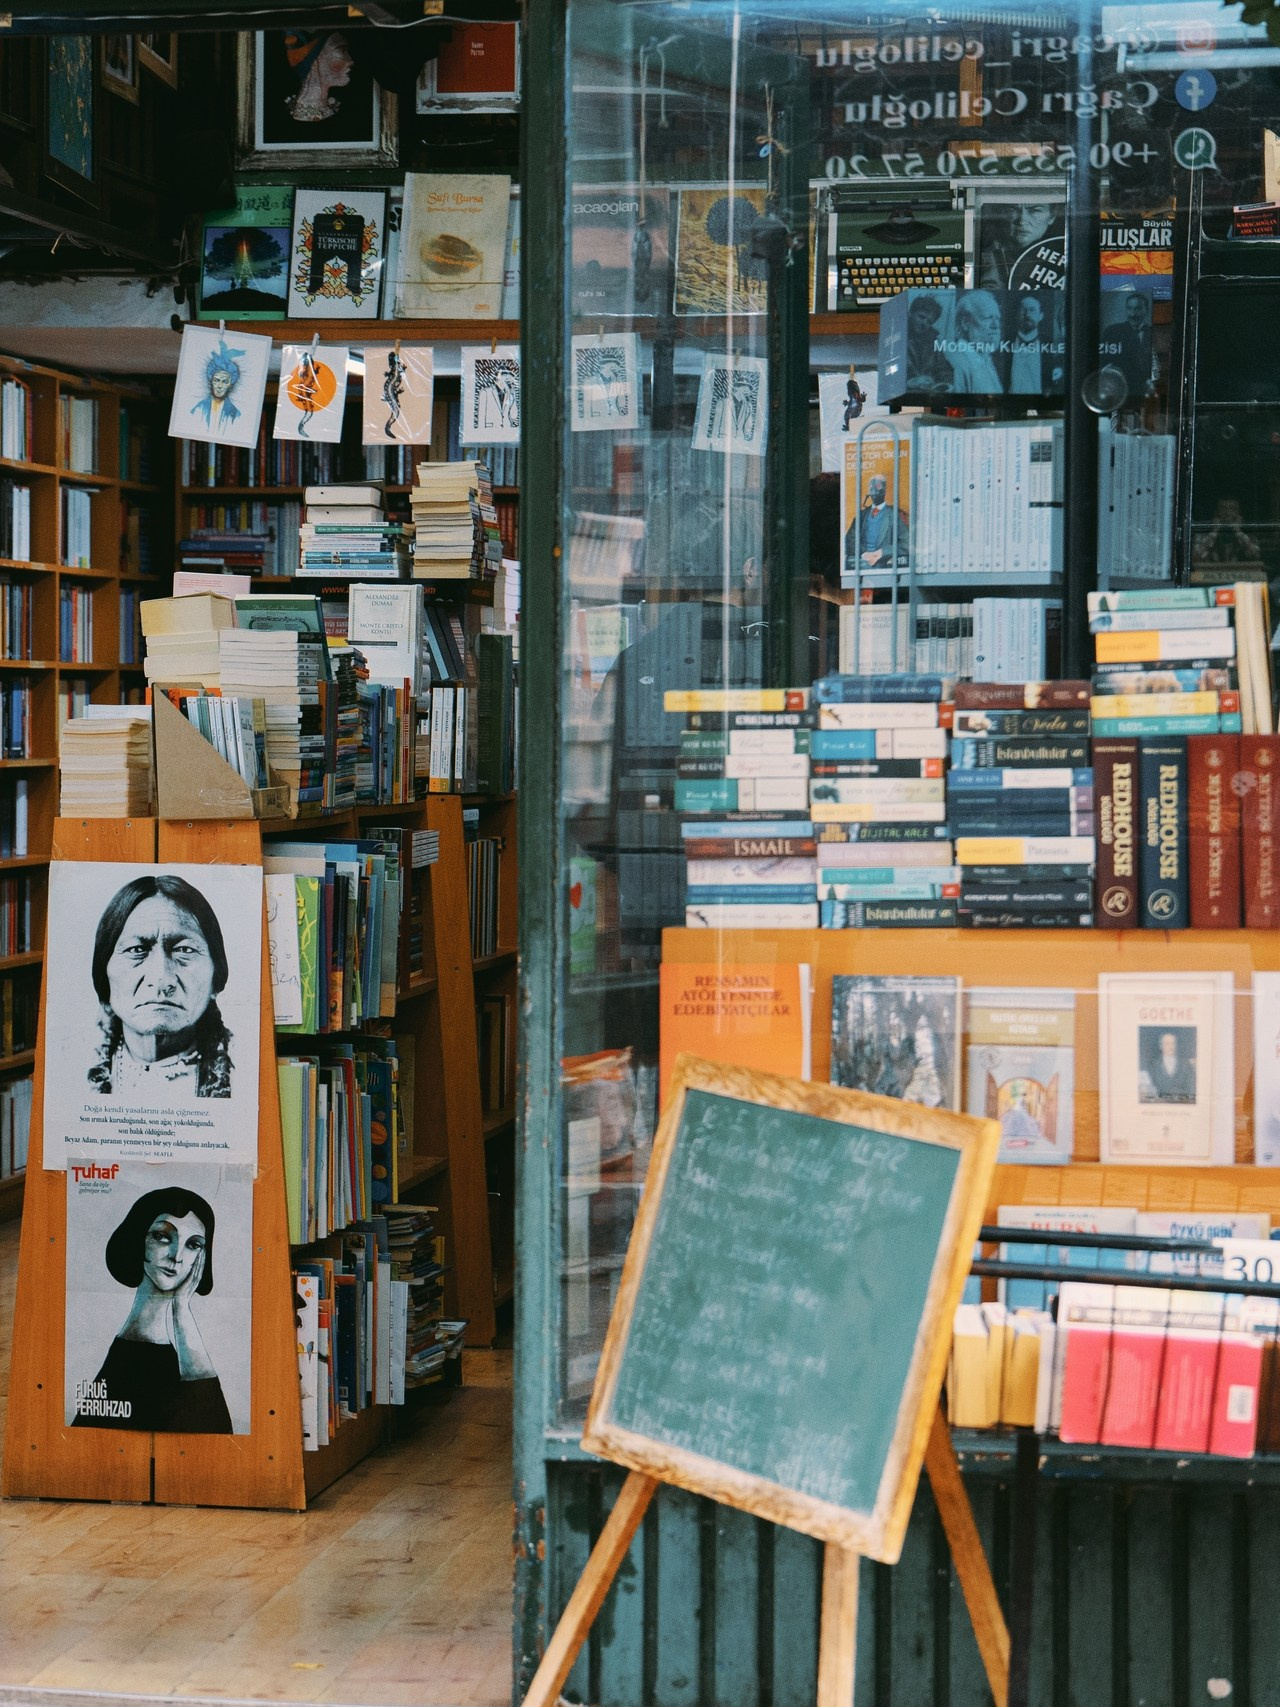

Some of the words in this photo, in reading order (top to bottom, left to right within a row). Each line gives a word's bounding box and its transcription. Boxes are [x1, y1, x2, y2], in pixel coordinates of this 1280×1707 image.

[471, 41, 484, 49] HARRY
[470, 49, 485, 57] POTTER
[428, 191, 450, 204] Sufi
[452, 192, 484, 204] Bursa
[1143, 218, 1173, 229] Büyük
[318, 236, 358, 244] TÜRKISCHE
[933, 338, 994, 353] MODERN
[1022, 715, 1068, 731] Veda
[1112, 762, 1133, 877] REDHOUSE
[1159, 764, 1179, 880] REDHOUSE
[733, 839, 794, 857] İSMAİL
[695, 975, 770, 987] RESSAMIN
[673, 1003, 790, 1018] EDEBİYATÇILAR
[1138, 1006, 1194, 1021] GOETHE
[84, 1104, 103, 1114] Doğa
[104, 1105, 124, 1114] kendi
[125, 1107, 159, 1116] yasalarını
[160, 1107, 175, 1115] asla
[176, 1107, 211, 1117] çiğnemez.
[109, 1117, 148, 1126] kuruduğunda,
[160, 1119, 172, 1127] ağaç
[64, 1136, 81, 1146] Beyaz
[82, 1137, 99, 1145] Adam,
[100, 1138, 122, 1146] paranın
[123, 1140, 152, 1148] yenmeyen
[162, 1140, 172, 1148] şey
[173, 1141, 200, 1149] olduğunu
[71, 1162, 120, 1183] Tuhaf
[79, 1180, 93, 1188] Sana
[75, 1378, 108, 1400] FÜRUĞ
[75, 1399, 132, 1418] FERRUHZAD
